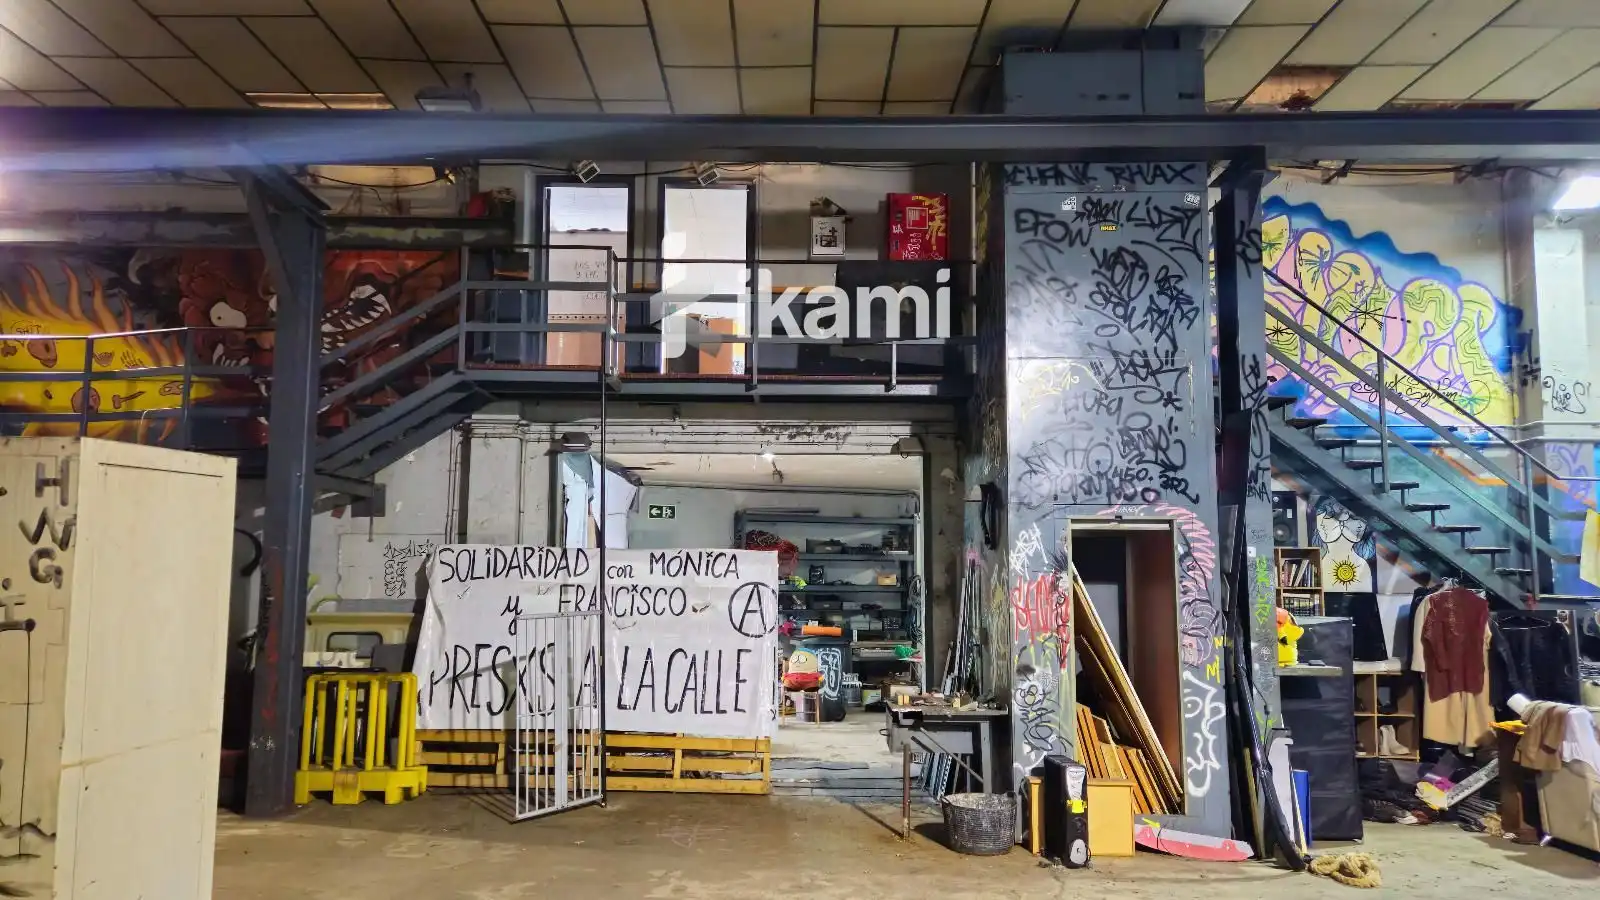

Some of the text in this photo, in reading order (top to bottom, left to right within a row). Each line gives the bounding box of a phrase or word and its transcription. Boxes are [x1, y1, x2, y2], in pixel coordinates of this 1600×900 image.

[607, 564, 635, 580] con
[501, 595, 523, 636] y
[576, 645, 598, 709] A
